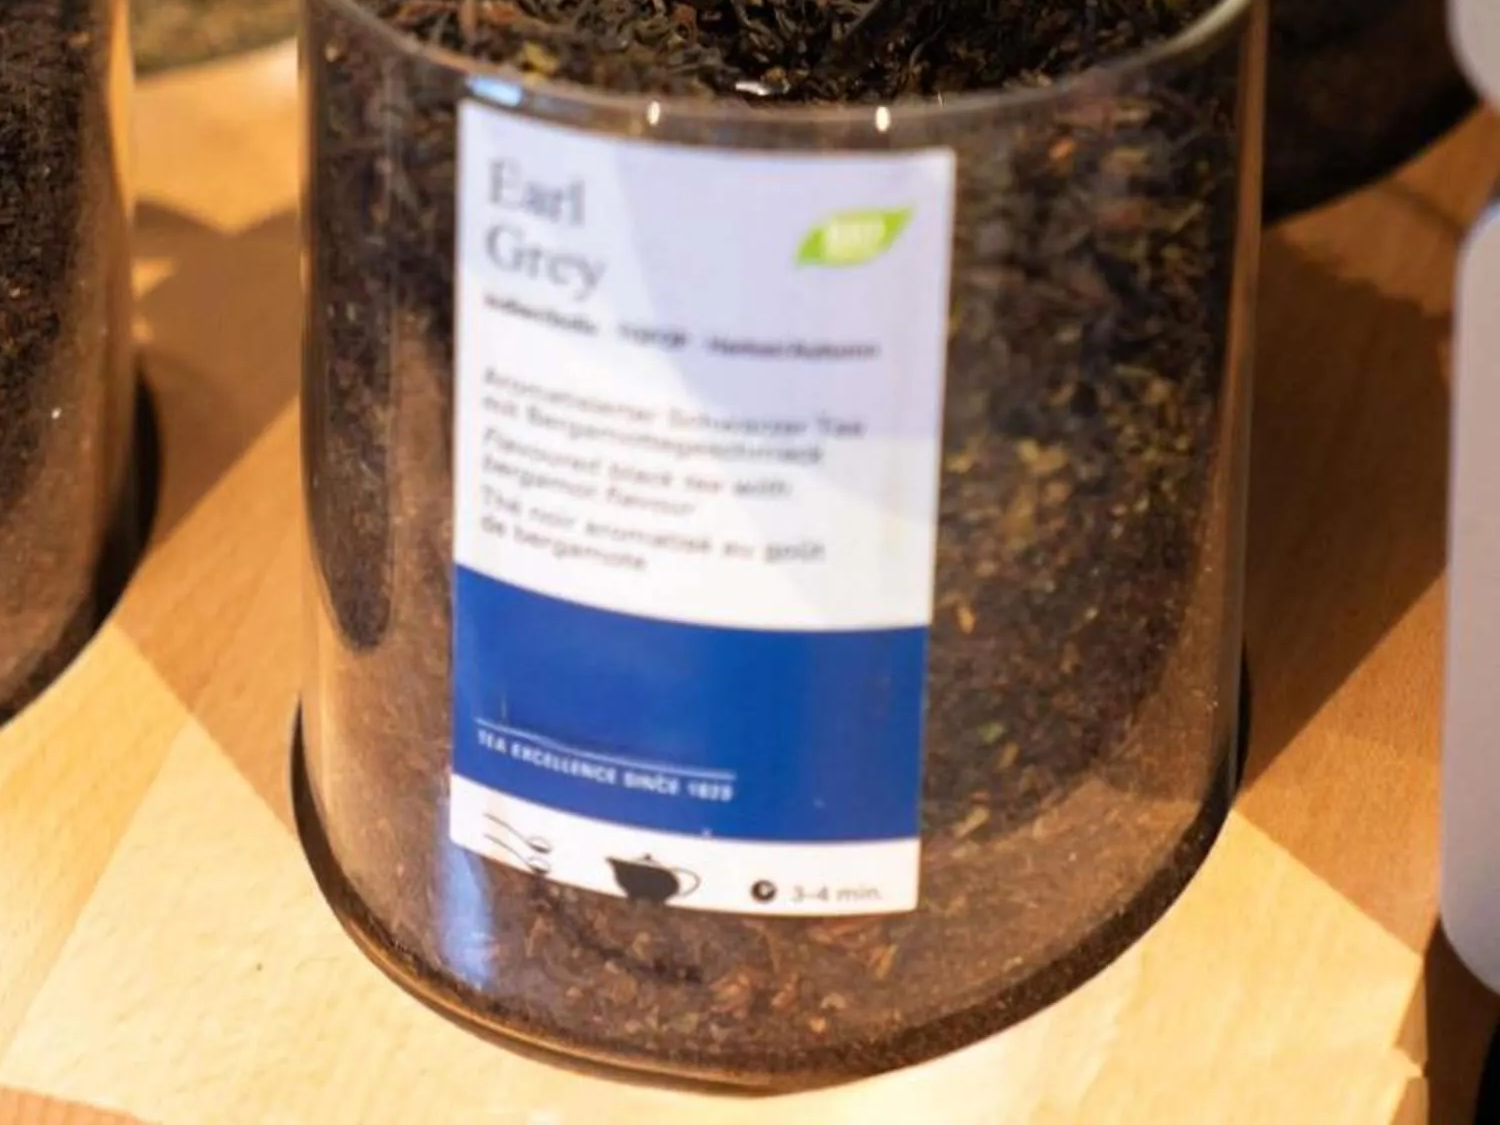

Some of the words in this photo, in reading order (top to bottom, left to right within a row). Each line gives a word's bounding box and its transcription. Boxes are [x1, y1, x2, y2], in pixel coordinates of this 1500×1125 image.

[488, 160, 586, 226] Earl
[484, 224, 605, 302] Grey
[478, 730, 507, 754] TEA
[511, 743, 617, 785] EXCELLENCE
[624, 771, 680, 797] SINCE
[837, 884, 882, 902] min.
